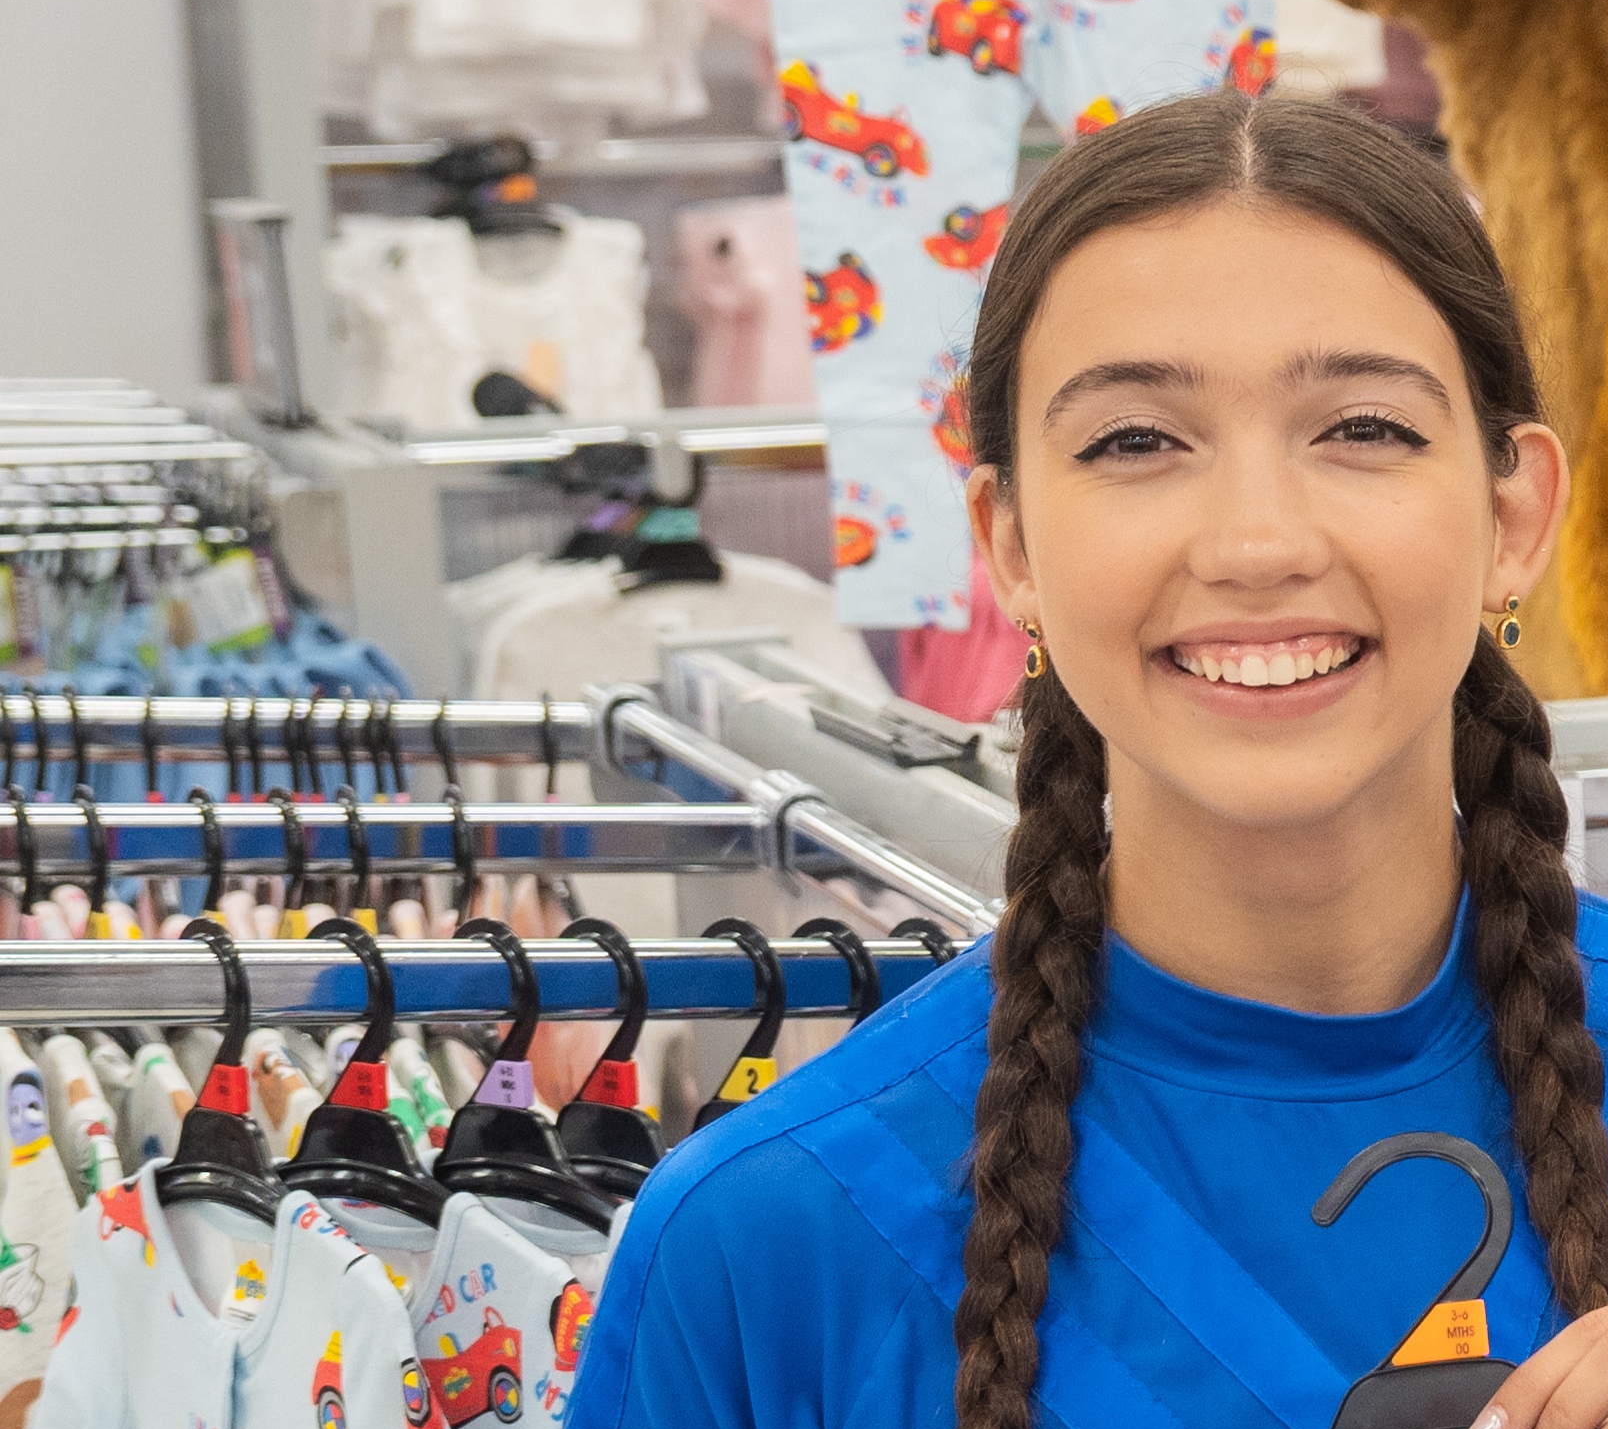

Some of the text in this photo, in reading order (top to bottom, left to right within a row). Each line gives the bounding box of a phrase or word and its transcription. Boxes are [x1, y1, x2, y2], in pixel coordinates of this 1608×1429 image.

[459, 1262, 498, 1306] CAR
[1450, 1308, 1470, 1322] 3-6
[1446, 1325, 1476, 1340] MTHS
[1455, 1342, 1471, 1356] 00
